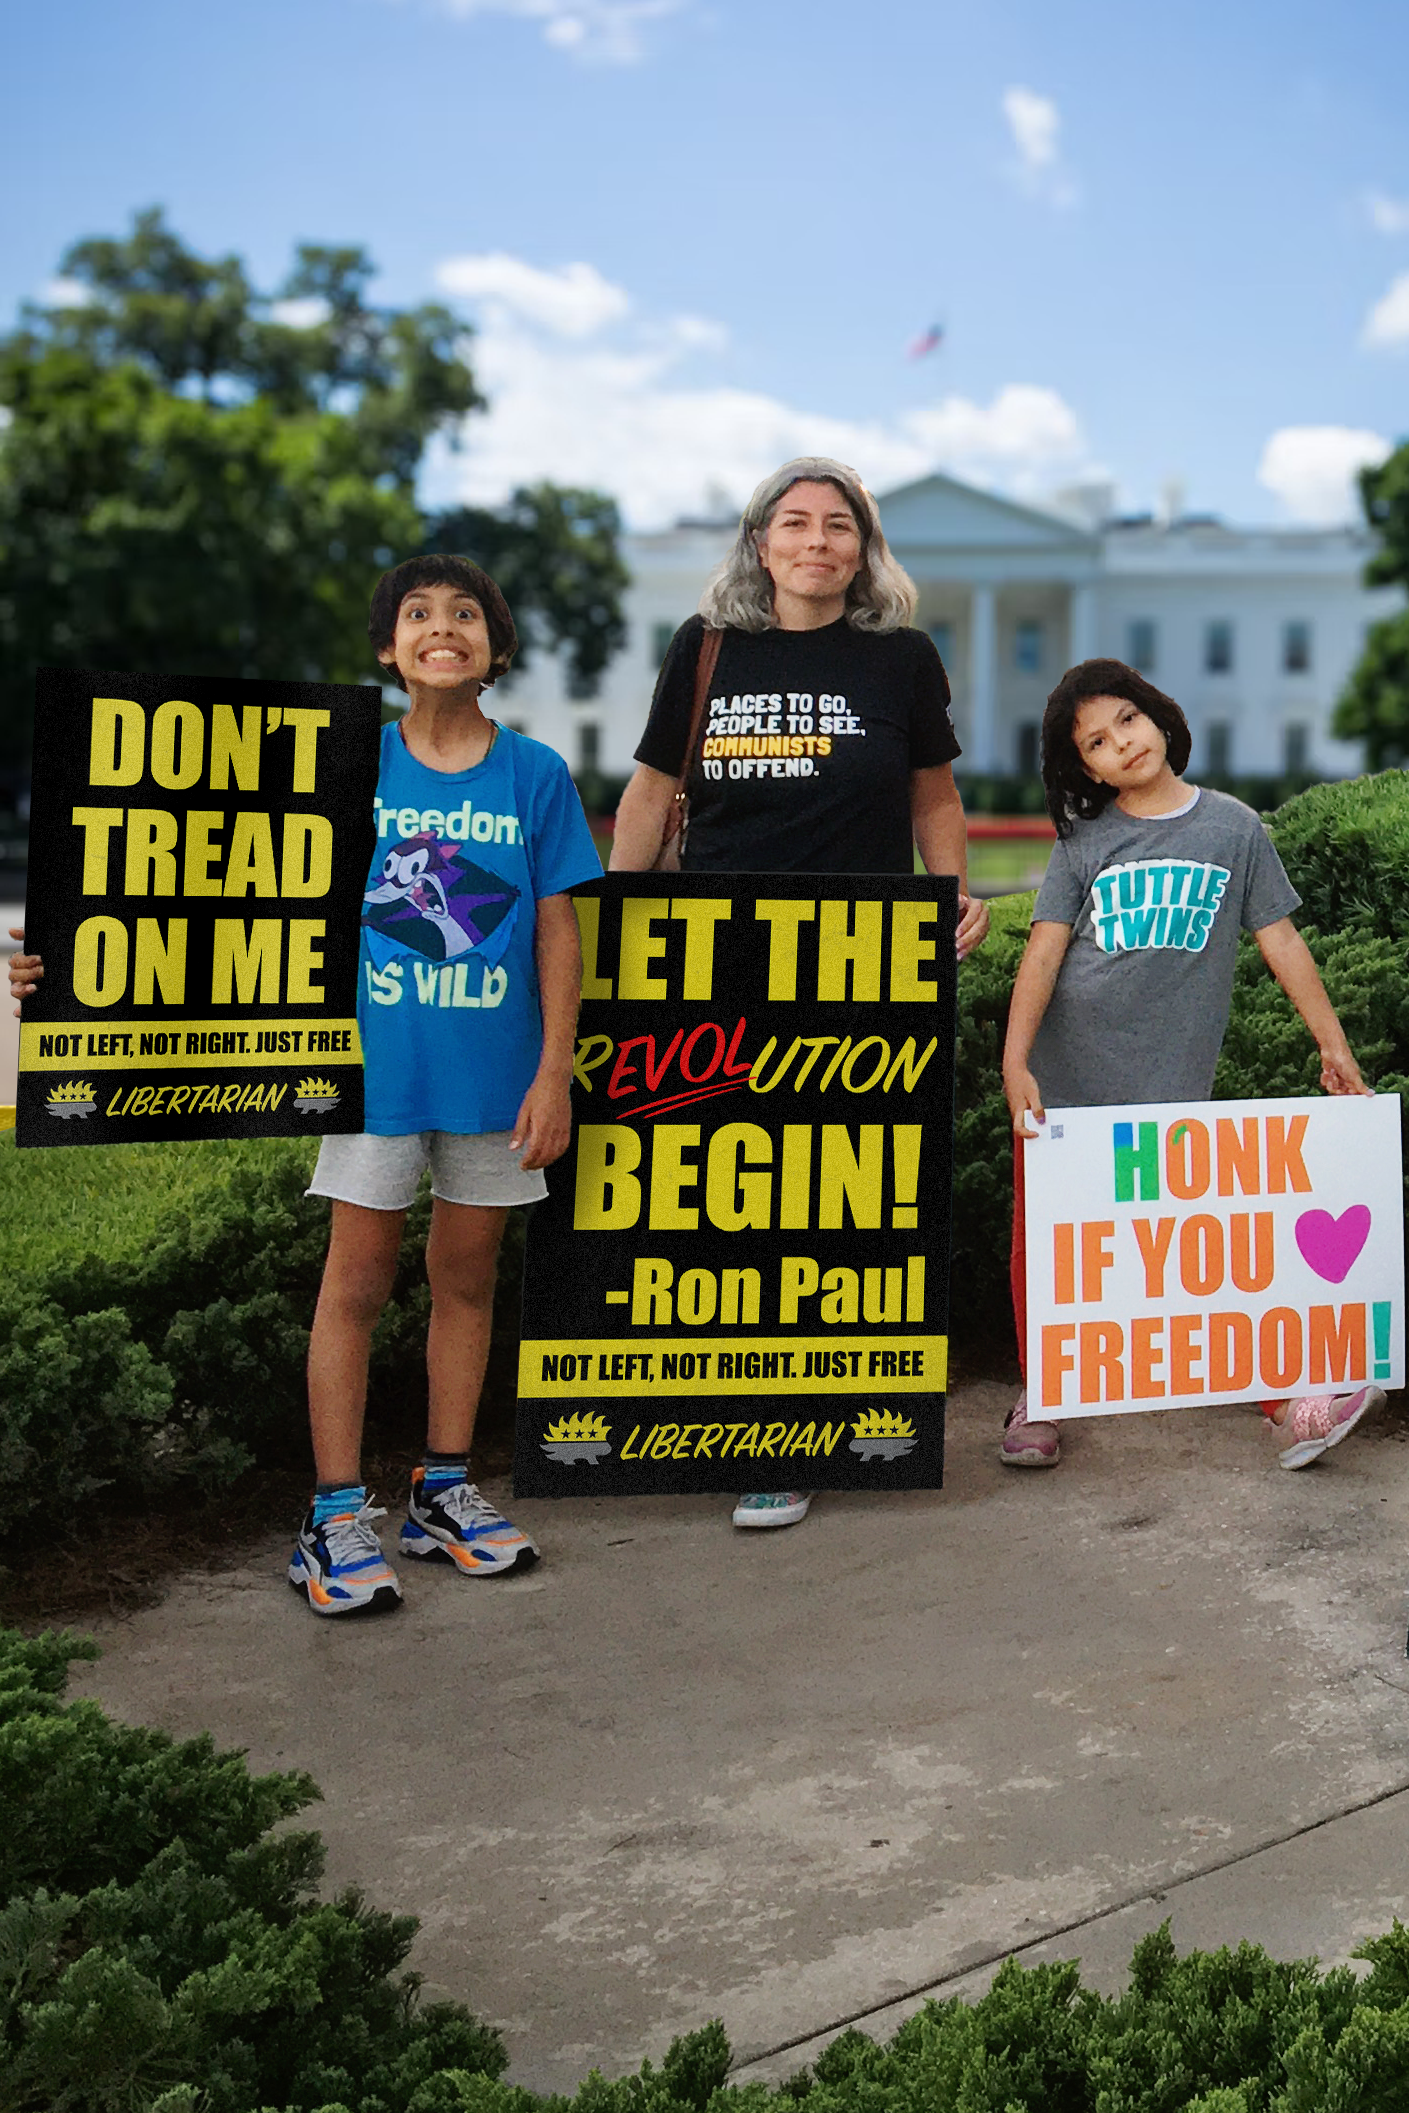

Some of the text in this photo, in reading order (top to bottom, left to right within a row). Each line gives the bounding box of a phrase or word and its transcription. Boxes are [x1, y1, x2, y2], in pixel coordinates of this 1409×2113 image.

[705, 714, 867, 737] PEOPLE TO SEE,
[709, 692, 852, 717] PLACES TO GO,
[89, 697, 331, 793] DON'T
[702, 736, 832, 758] COMMUNISTS
[702, 757, 820, 780] TO OFFEND.
[72, 806, 334, 898] TREAD
[1093, 865, 1229, 915] TUTTLE
[572, 896, 939, 1003] LET THE
[1098, 907, 1212, 953] TWINS
[72, 915, 327, 1008] ON ME
[413, 961, 508, 1009] WILD
[39, 1029, 352, 1058] NOT LEFT, NOT RIGHT. JUST FREE
[573, 1016, 938, 1099] REVOLUTION
[105, 1083, 288, 1118] LIBERTARIAN
[573, 1122, 923, 1232] BEGIN!
[1112, 1114, 1314, 1203] HONK
[1053, 1210, 1275, 1305] IF YOU
[605, 1255, 926, 1326] -Ron Paul
[541, 1350, 924, 1383] NOT LEFT, NOT RIGHT. JUST FREE
[1041, 1300, 1392, 1408] FREEDOM!
[619, 1420, 846, 1461] LIBERTARIAN
